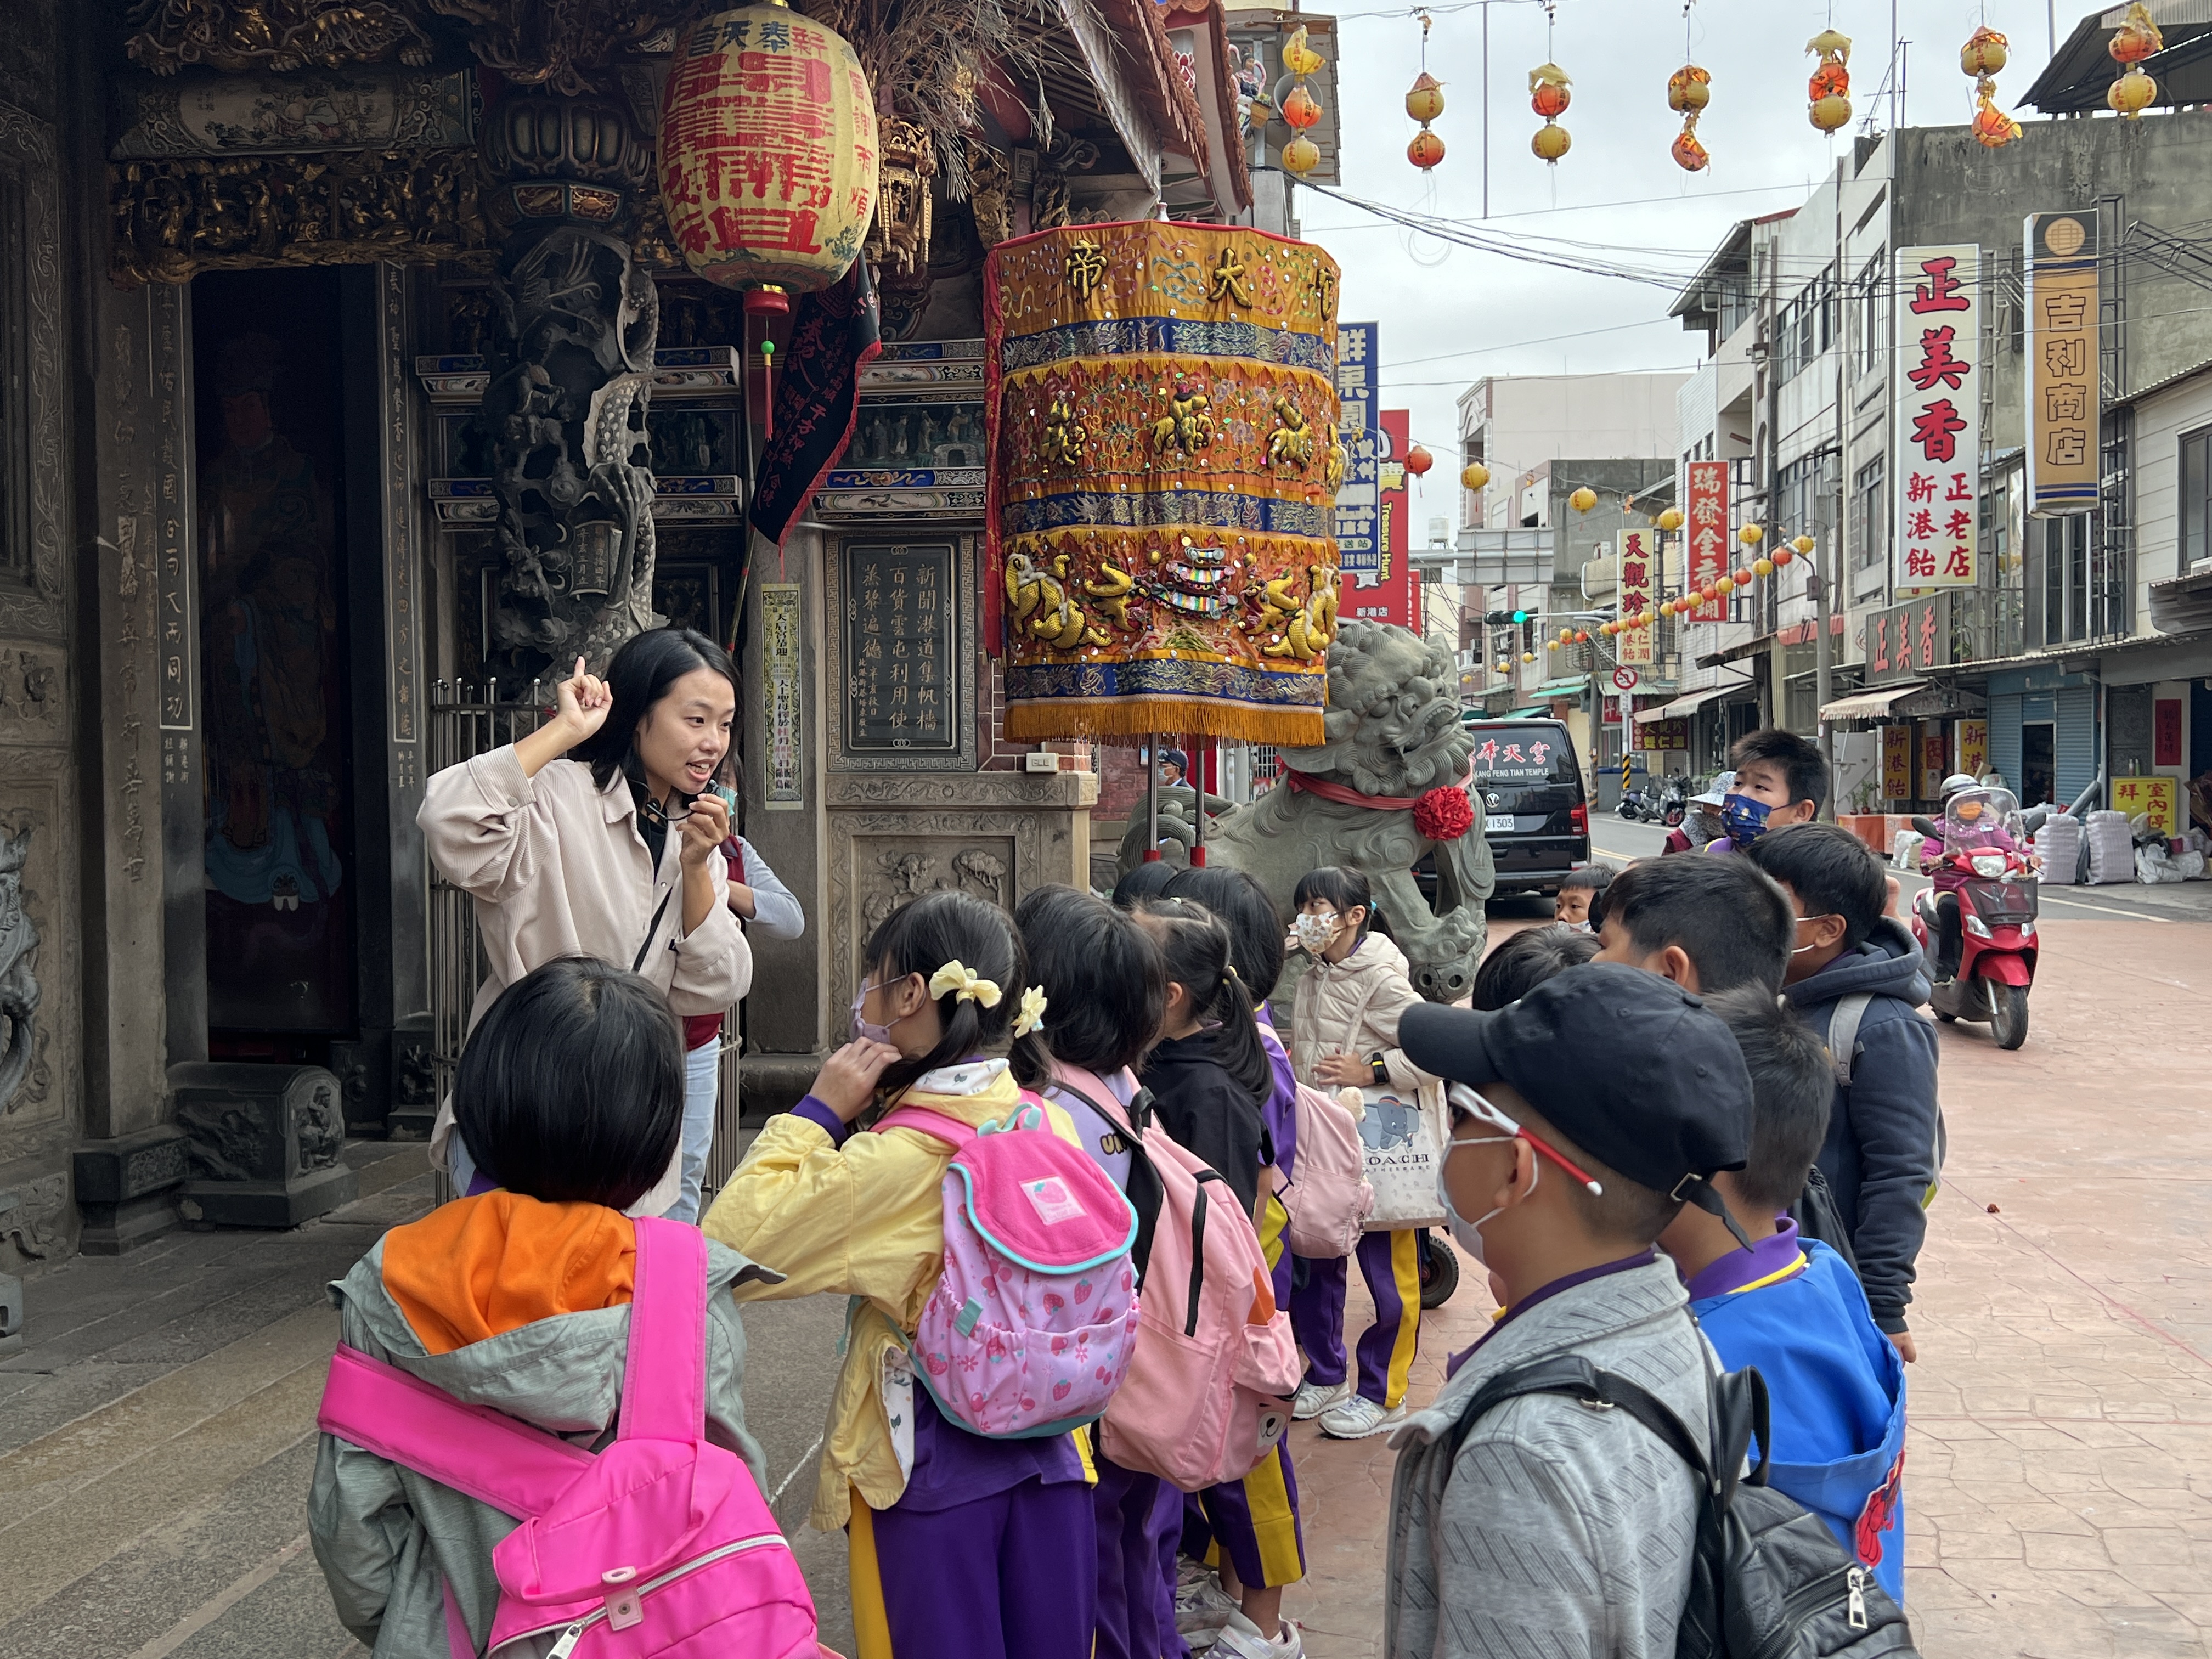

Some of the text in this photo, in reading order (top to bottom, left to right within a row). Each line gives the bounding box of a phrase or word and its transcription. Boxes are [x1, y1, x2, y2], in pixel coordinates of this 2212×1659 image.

[1907, 256, 1971, 464] 正美香
[2045, 294, 2086, 466] 吉利商店
[1381, 501, 1392, 581] Treasure Hunt
[1905, 472, 1939, 578] 新港飴
[1943, 473, 1973, 578] 正老店
[1356, 606, 1389, 617] 新港店
[1622, 533, 1650, 616] 天觀珍
[1874, 606, 1938, 674] 正美香
[1492, 769, 1509, 777] FENG
[1510, 769, 1525, 777] TIAN
[1525, 768, 1549, 776] TEMPLE
[1886, 730, 1907, 797] 新港飴
[1364, 1154, 1430, 1165] OACH
[1365, 1165, 1431, 1173] ATHERWARE
